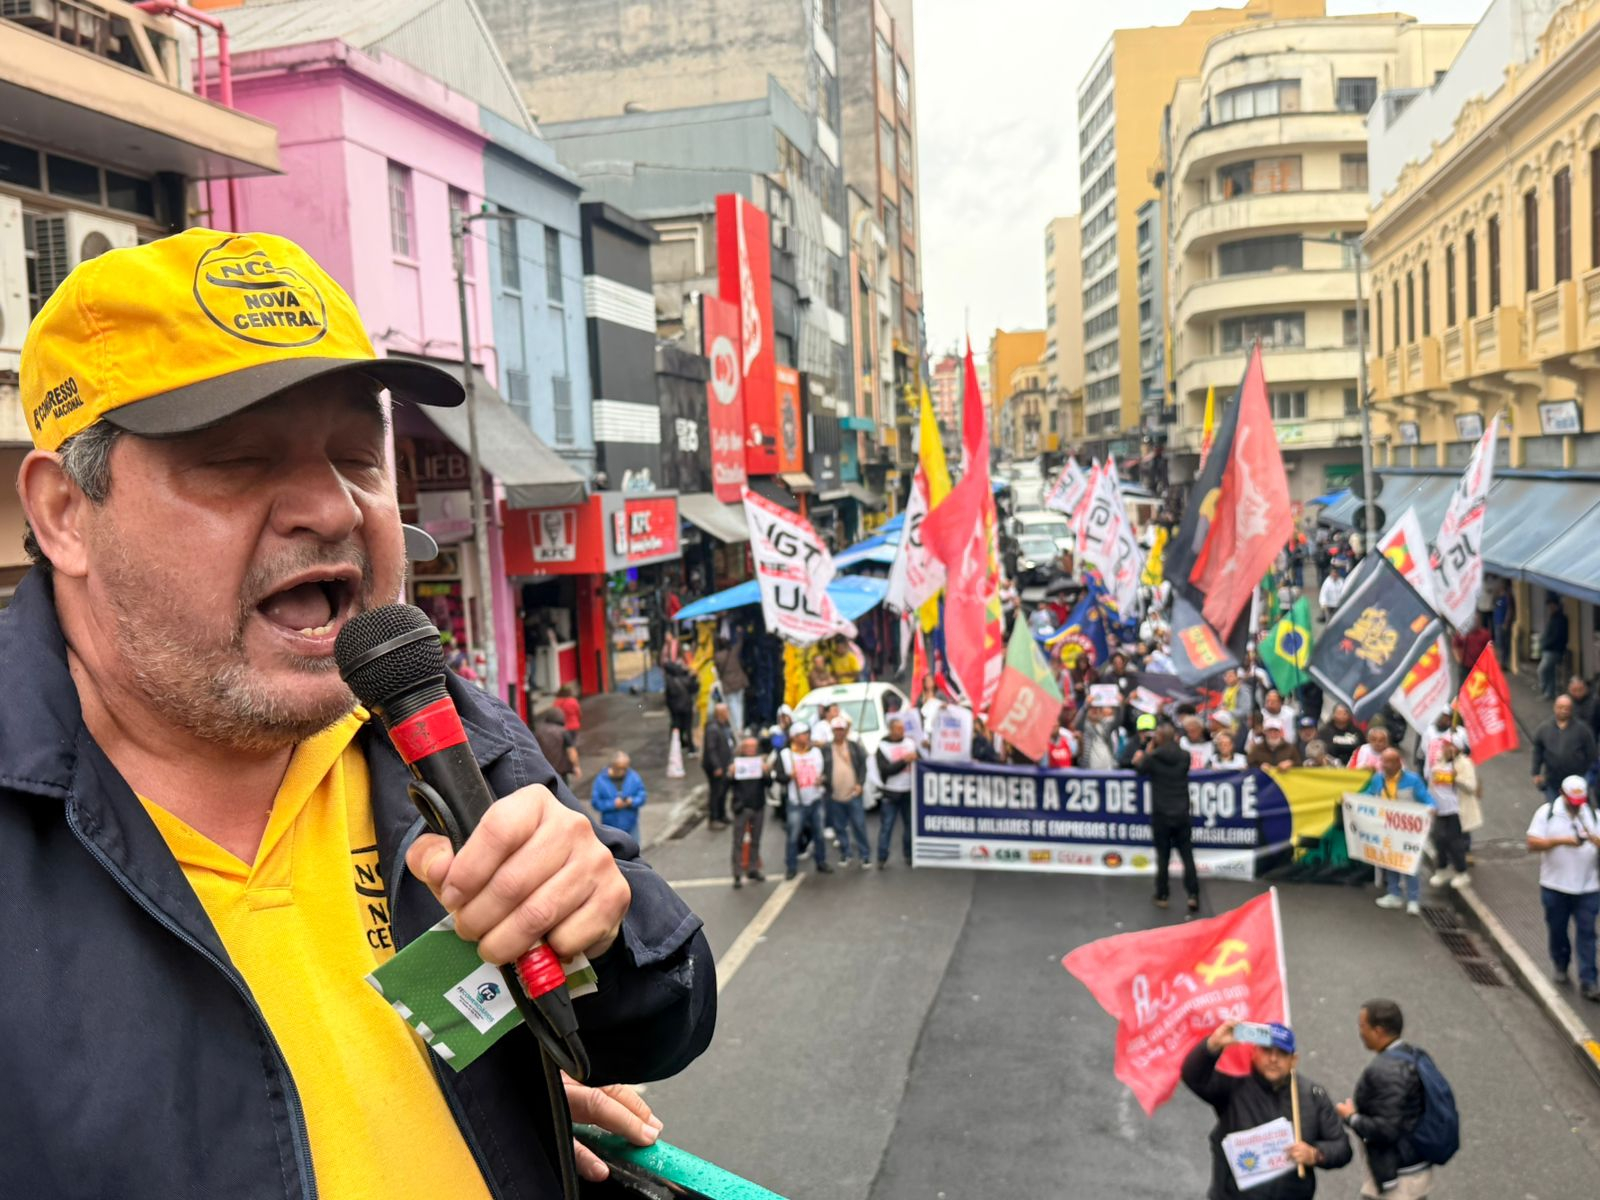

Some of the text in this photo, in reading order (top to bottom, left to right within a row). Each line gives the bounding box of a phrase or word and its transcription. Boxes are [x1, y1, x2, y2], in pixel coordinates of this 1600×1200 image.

[244, 290, 300, 310] NOVA
[233, 310, 321, 330] CENTRAL
[38, 376, 78, 422] CONGRESSO
[52, 395, 84, 419] NACIONAL
[540, 548, 566, 559] KFC
[922, 771, 1037, 809] DEFENDER
[1042, 777, 1061, 811] A
[1065, 779, 1100, 813] 25
[1105, 779, 1138, 814] DE
[1241, 774, 1259, 819] É
[924, 815, 976, 834] DEFENDER
[977, 817, 1031, 836] MILHARES
[1032, 819, 1047, 836] DE
[1048, 820, 1108, 839] EMPREGOS
[1109, 822, 1117, 839] E
[1118, 823, 1127, 840] O
